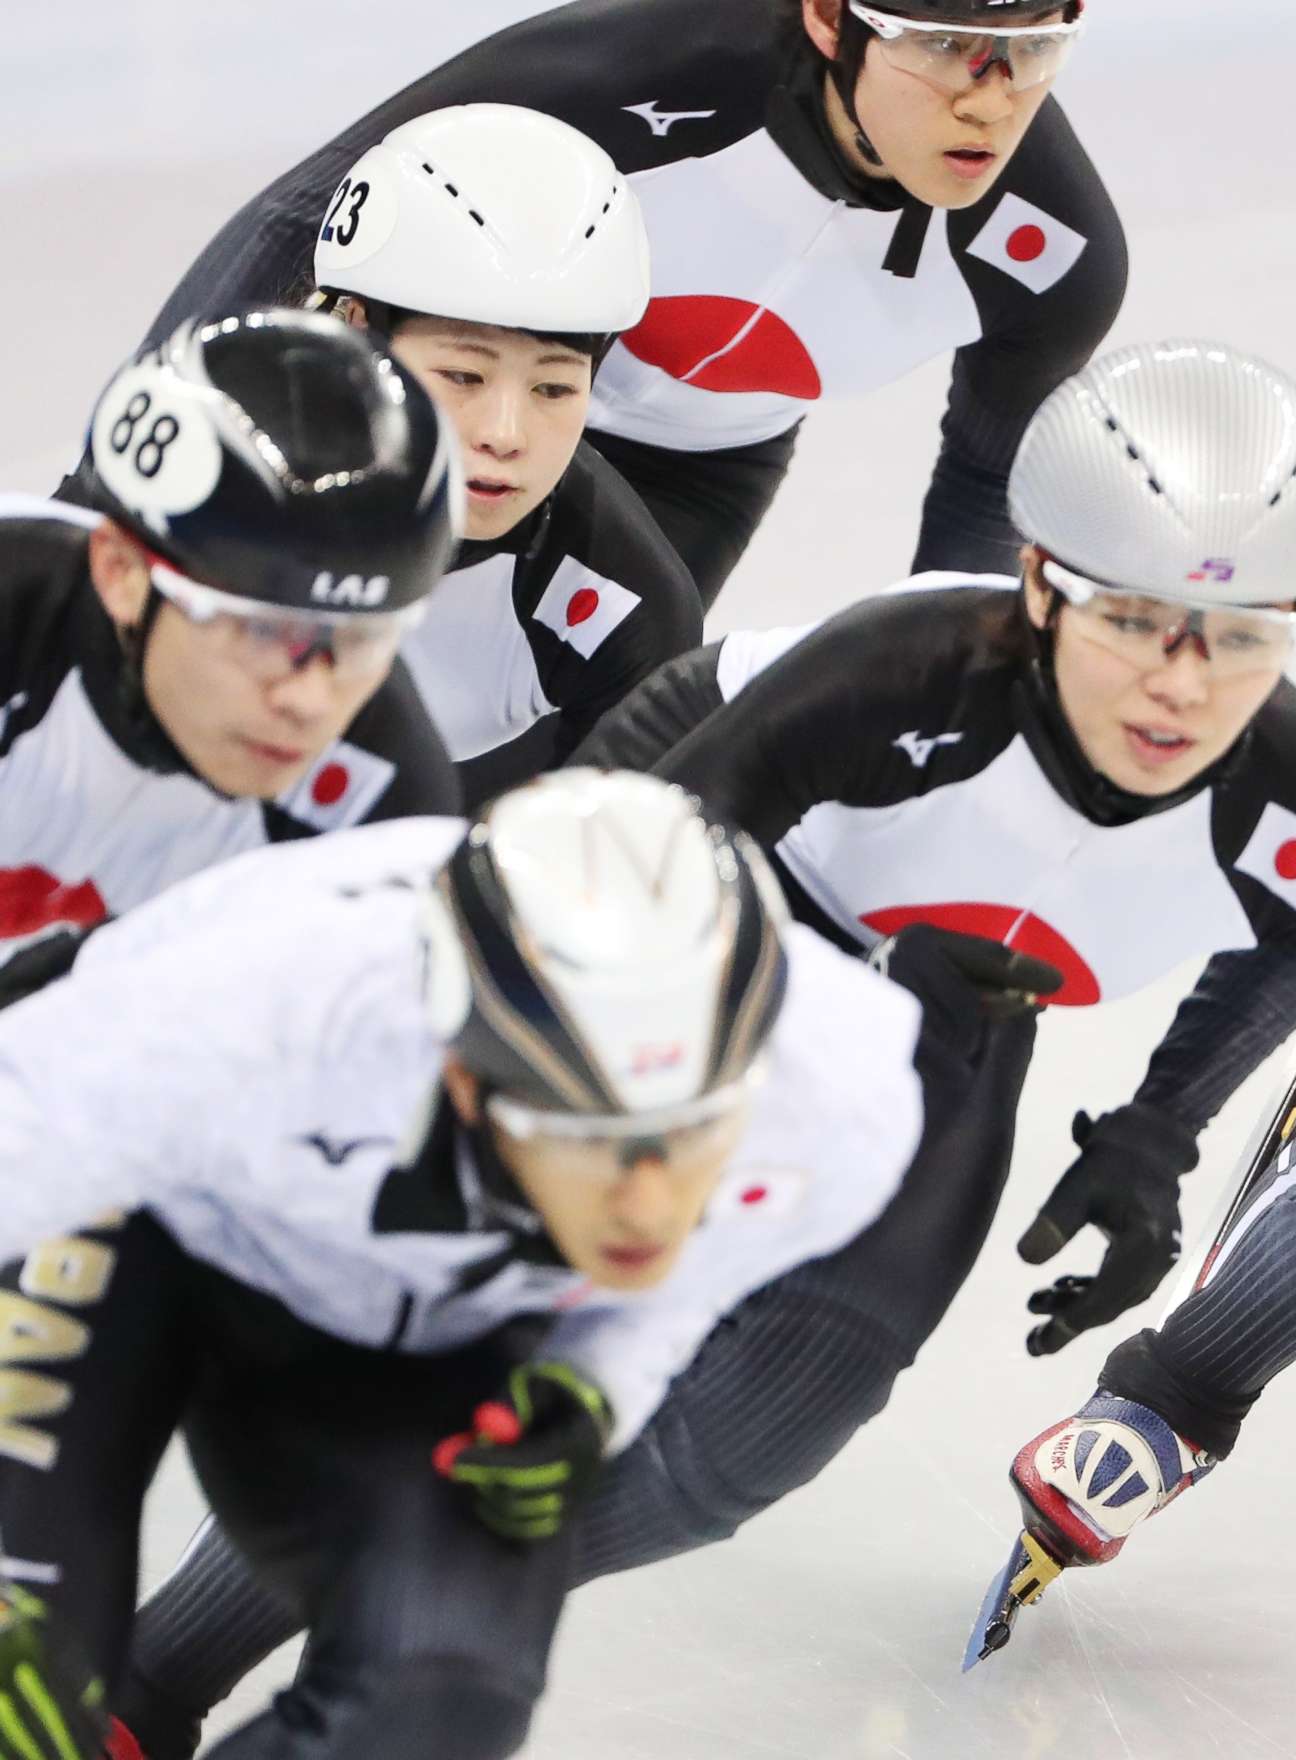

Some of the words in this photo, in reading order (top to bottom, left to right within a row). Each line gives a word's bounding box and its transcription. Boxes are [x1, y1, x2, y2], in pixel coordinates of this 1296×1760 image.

[321, 177, 370, 247] 23
[111, 391, 179, 478] 88
[0, 1208, 127, 1472] PAN
